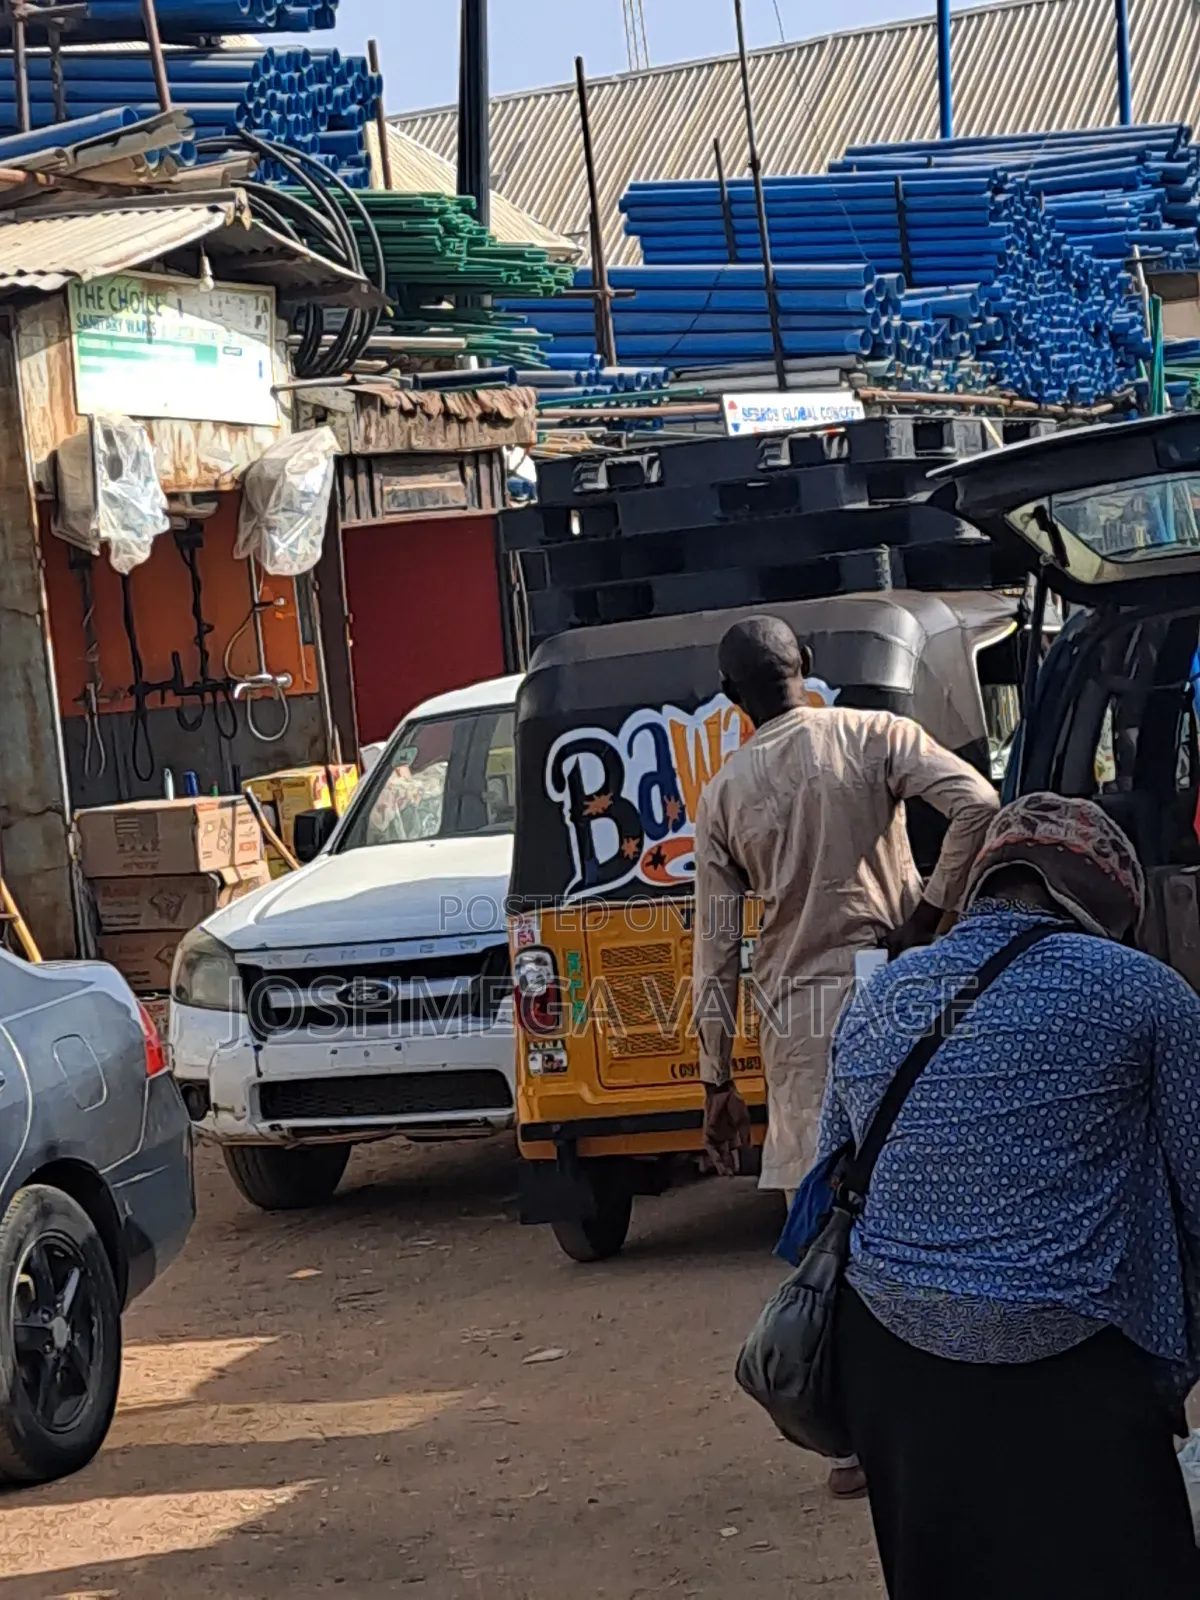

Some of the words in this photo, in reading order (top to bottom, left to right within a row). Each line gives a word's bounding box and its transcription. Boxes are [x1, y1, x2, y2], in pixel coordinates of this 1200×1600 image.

[75, 284, 104, 311] THE
[108, 287, 163, 317] CHOICE
[782, 406, 819, 421] GLOBAL
